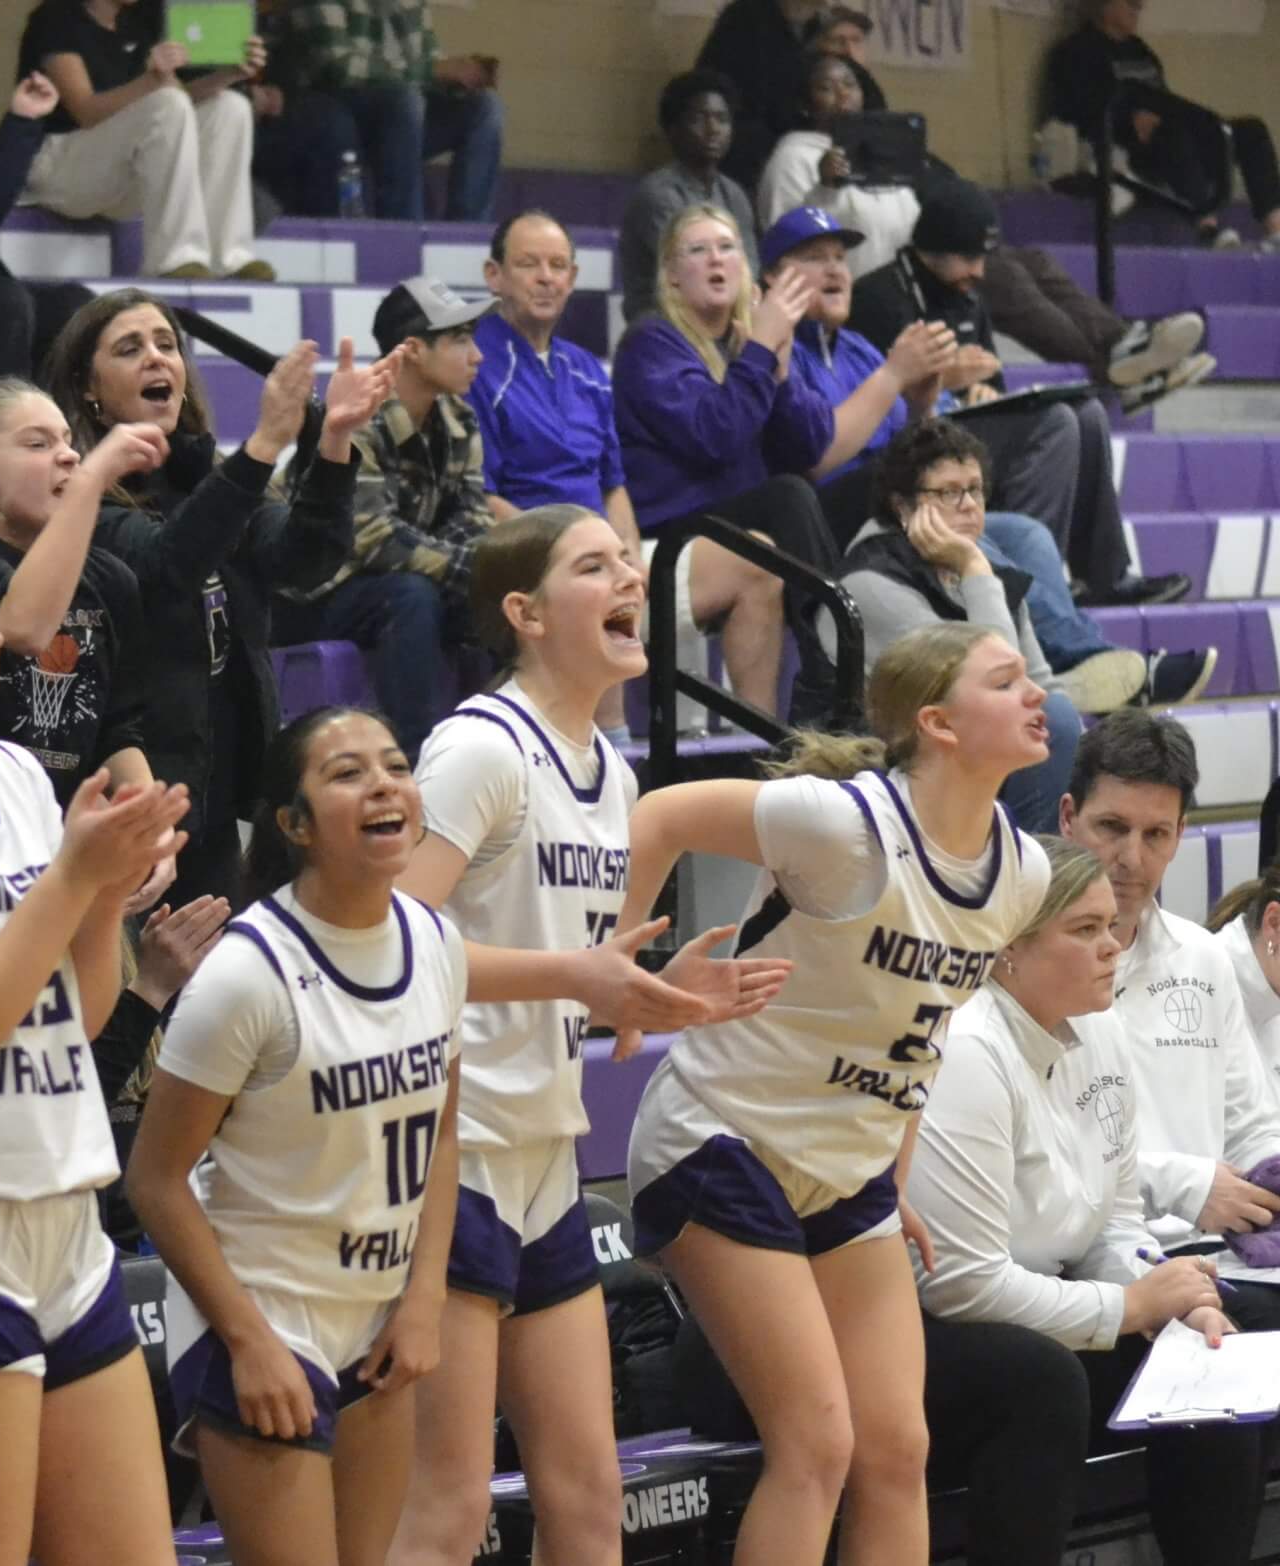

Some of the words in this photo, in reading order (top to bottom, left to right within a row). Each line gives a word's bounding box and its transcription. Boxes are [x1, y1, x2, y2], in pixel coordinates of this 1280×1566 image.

[1146, 976, 1216, 998] Nooksack
[383, 1108, 438, 1208] 10
[621, 1476, 710, 1534] ONEERS
